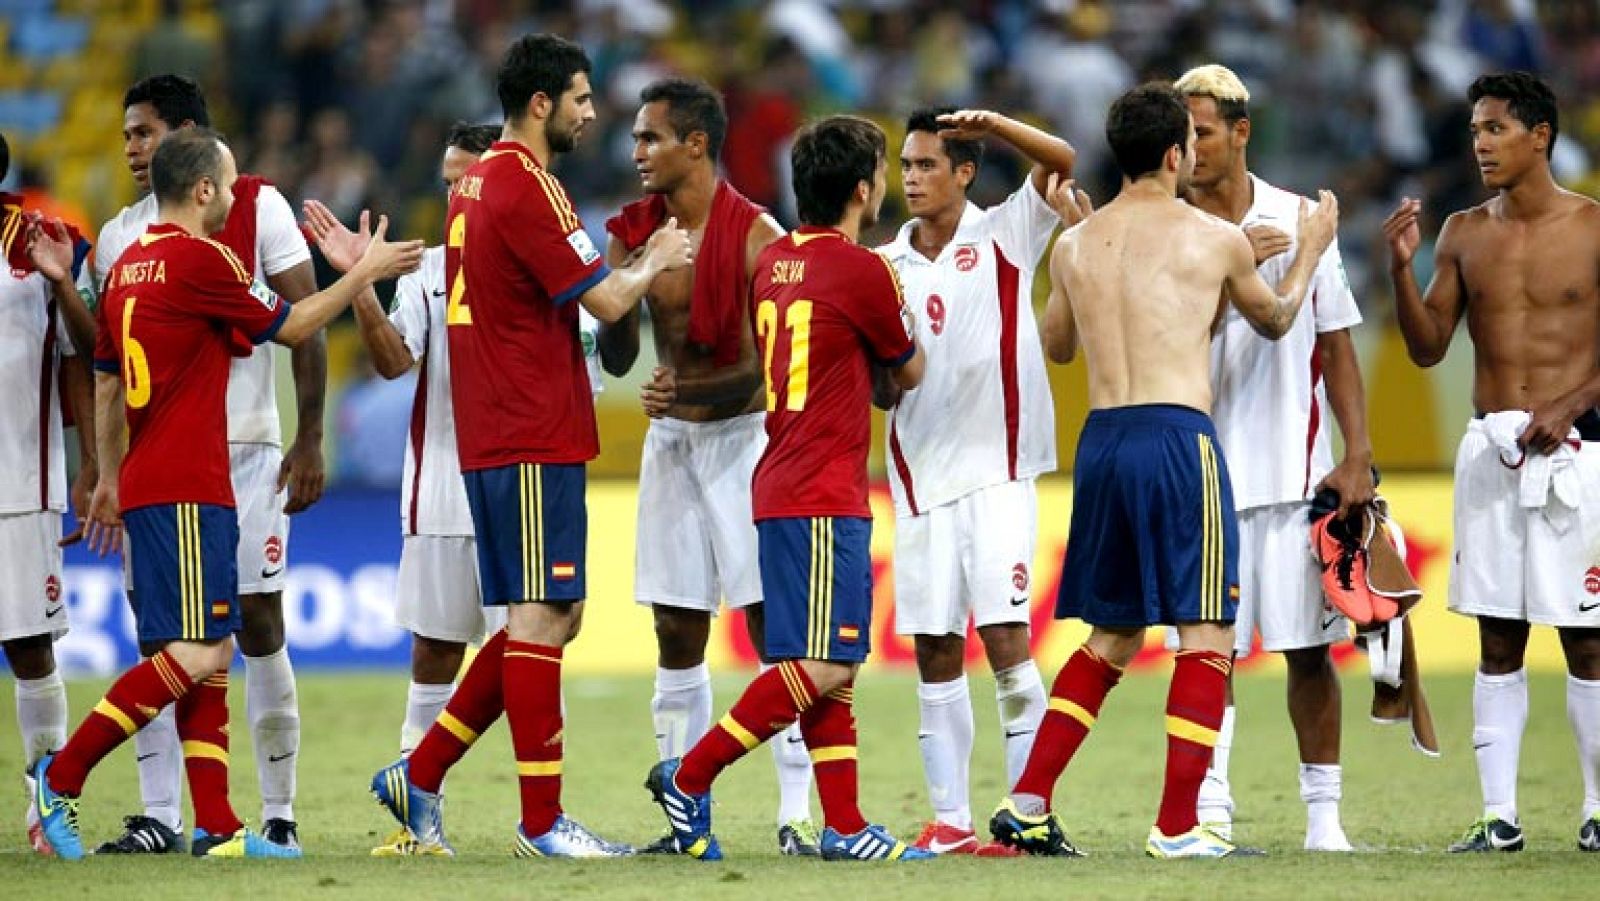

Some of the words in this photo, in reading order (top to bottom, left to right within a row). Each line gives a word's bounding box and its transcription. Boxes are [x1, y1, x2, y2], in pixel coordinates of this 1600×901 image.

[446, 212, 474, 325] 2
[770, 260, 805, 284] SILVA
[926, 293, 946, 336] 9
[122, 297, 151, 410] 6
[756, 299, 814, 413] 21
